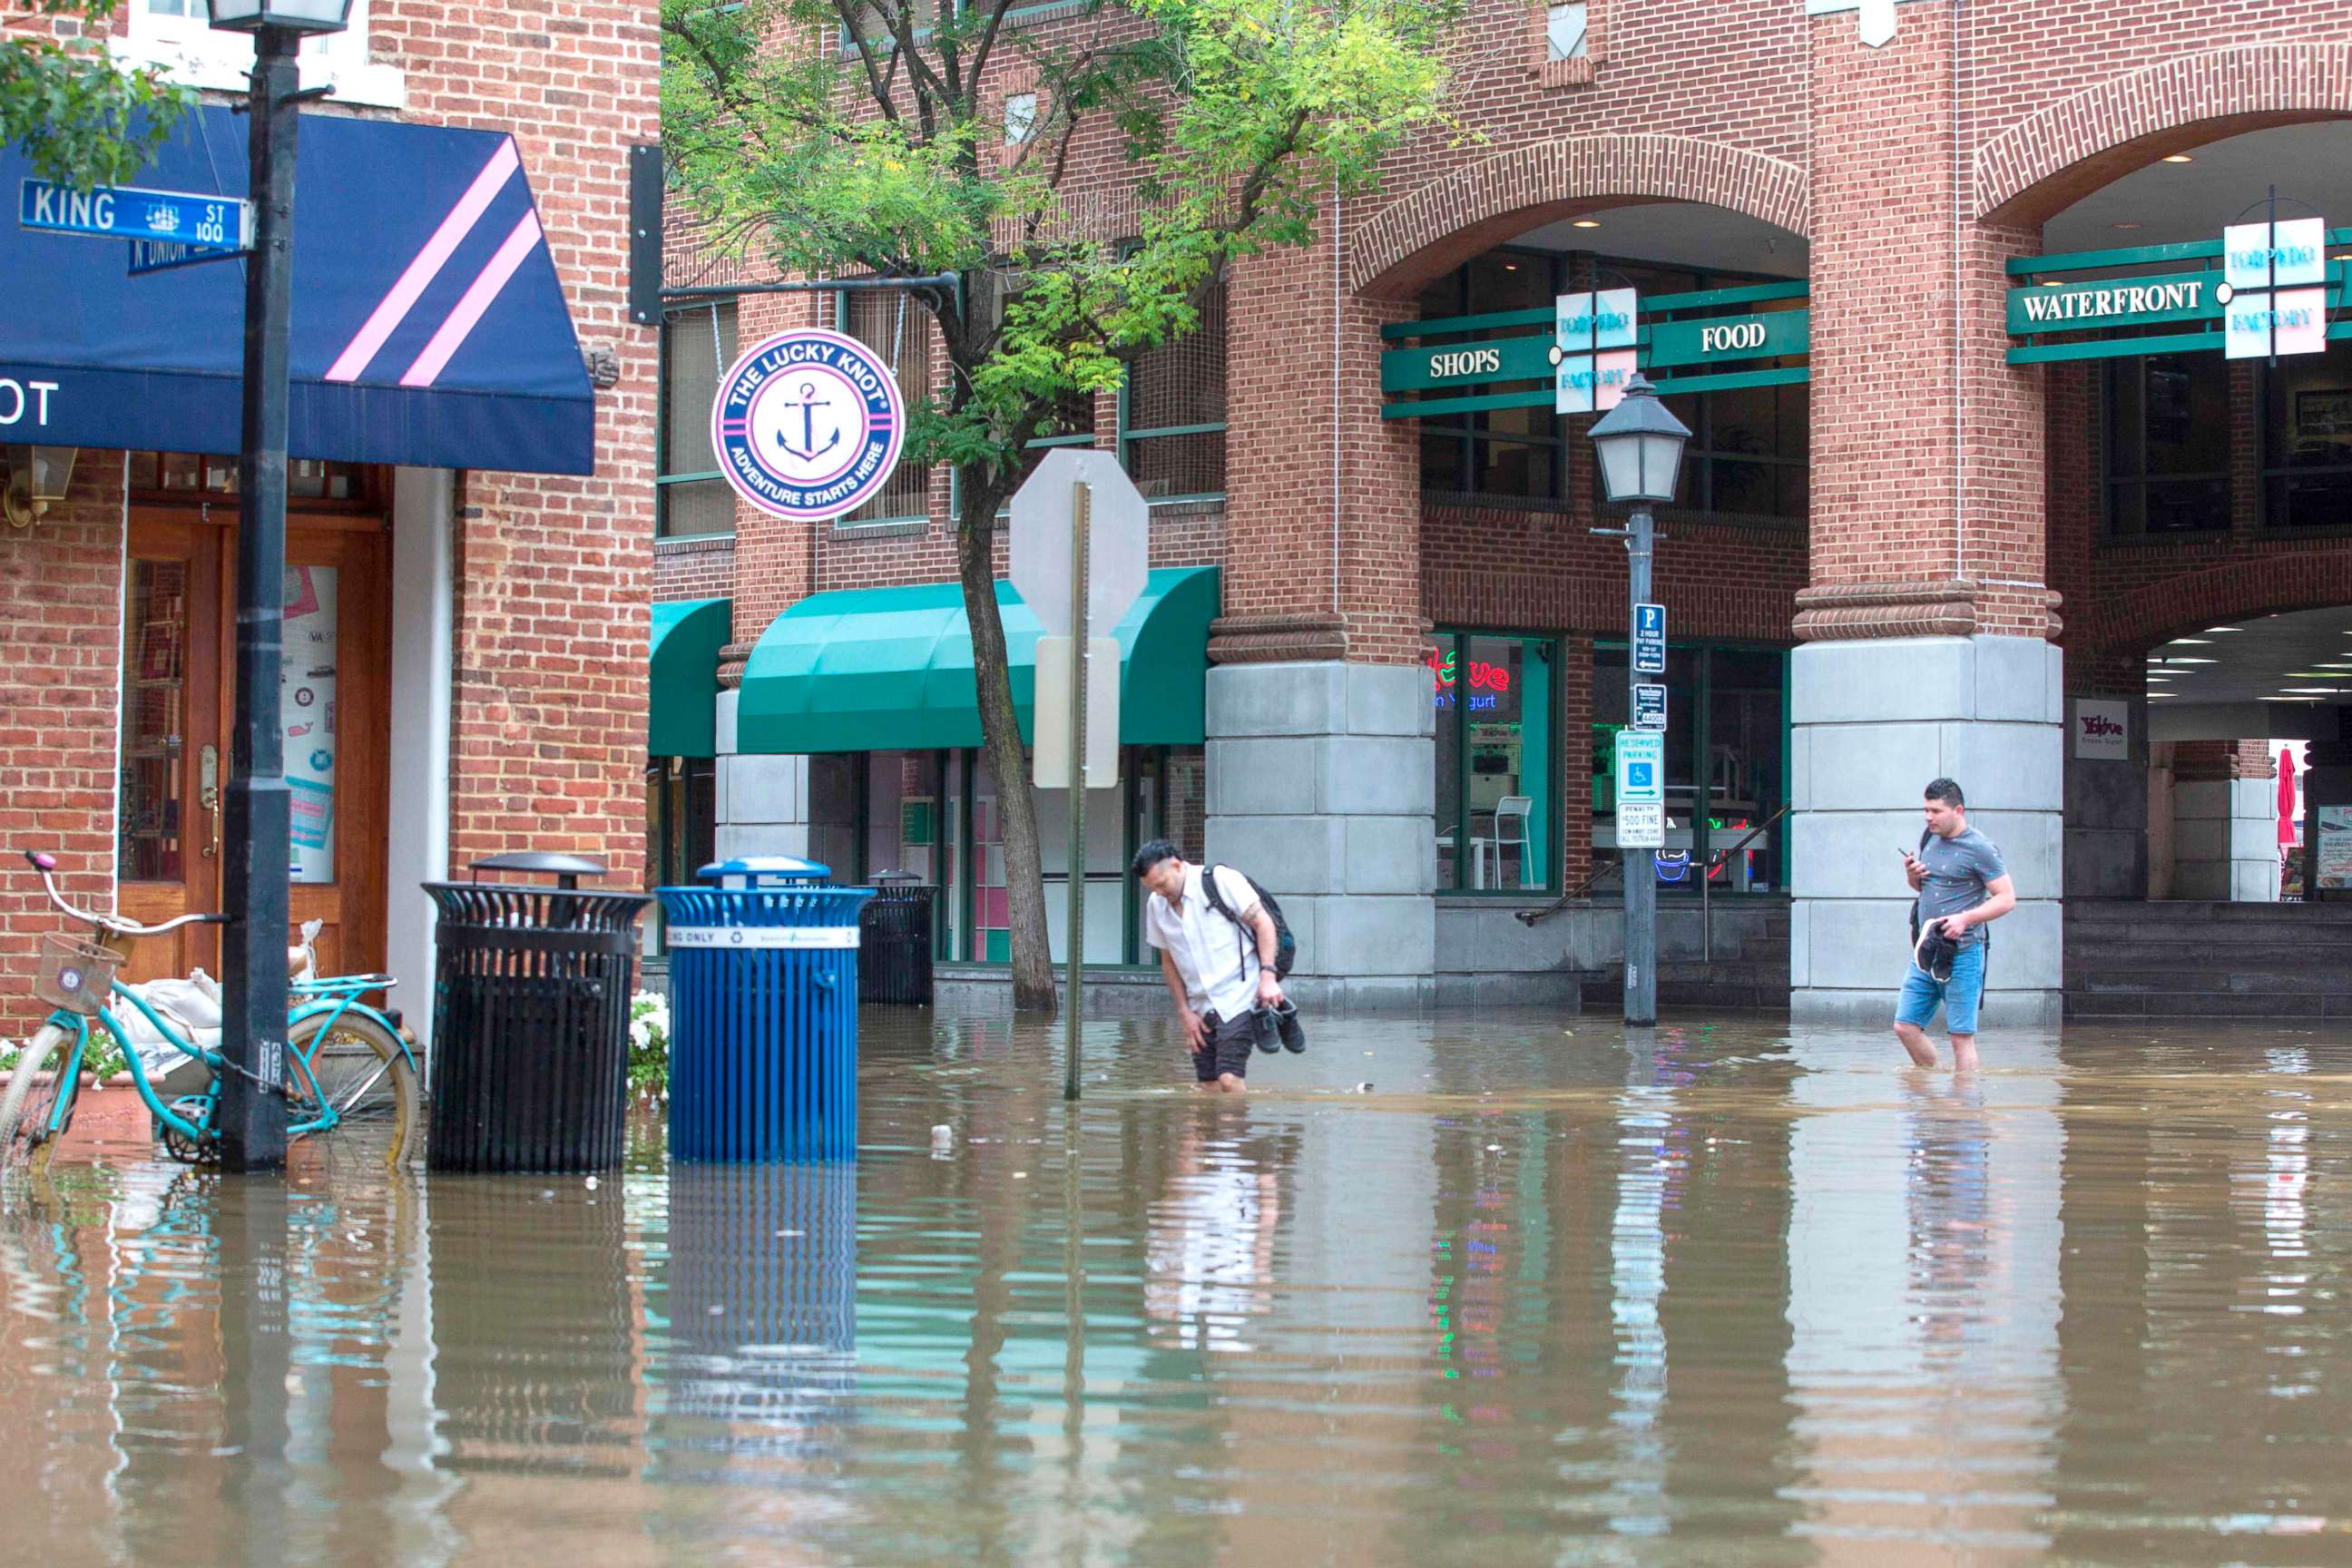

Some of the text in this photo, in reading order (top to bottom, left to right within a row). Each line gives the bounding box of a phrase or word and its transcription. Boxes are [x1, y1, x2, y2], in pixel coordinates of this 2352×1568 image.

[34, 186, 115, 230] KING
[206, 204, 225, 223] ST
[196, 222, 224, 243] 100
[2024, 281, 2202, 321] WATERFRONT
[1701, 323, 1766, 353] FOOD
[1430, 348, 1501, 378] SHOPS
[730, 344, 885, 407] THE LUCKY KNOT
[730, 441, 884, 505] ADVENTURE STARTS HERE
[1645, 608, 1655, 628] P
[1620, 738, 1661, 748] RESERVED
[1622, 750, 1658, 760] PARKING
[1642, 815, 1659, 826] FINE
[686, 931, 715, 943] ONLY
